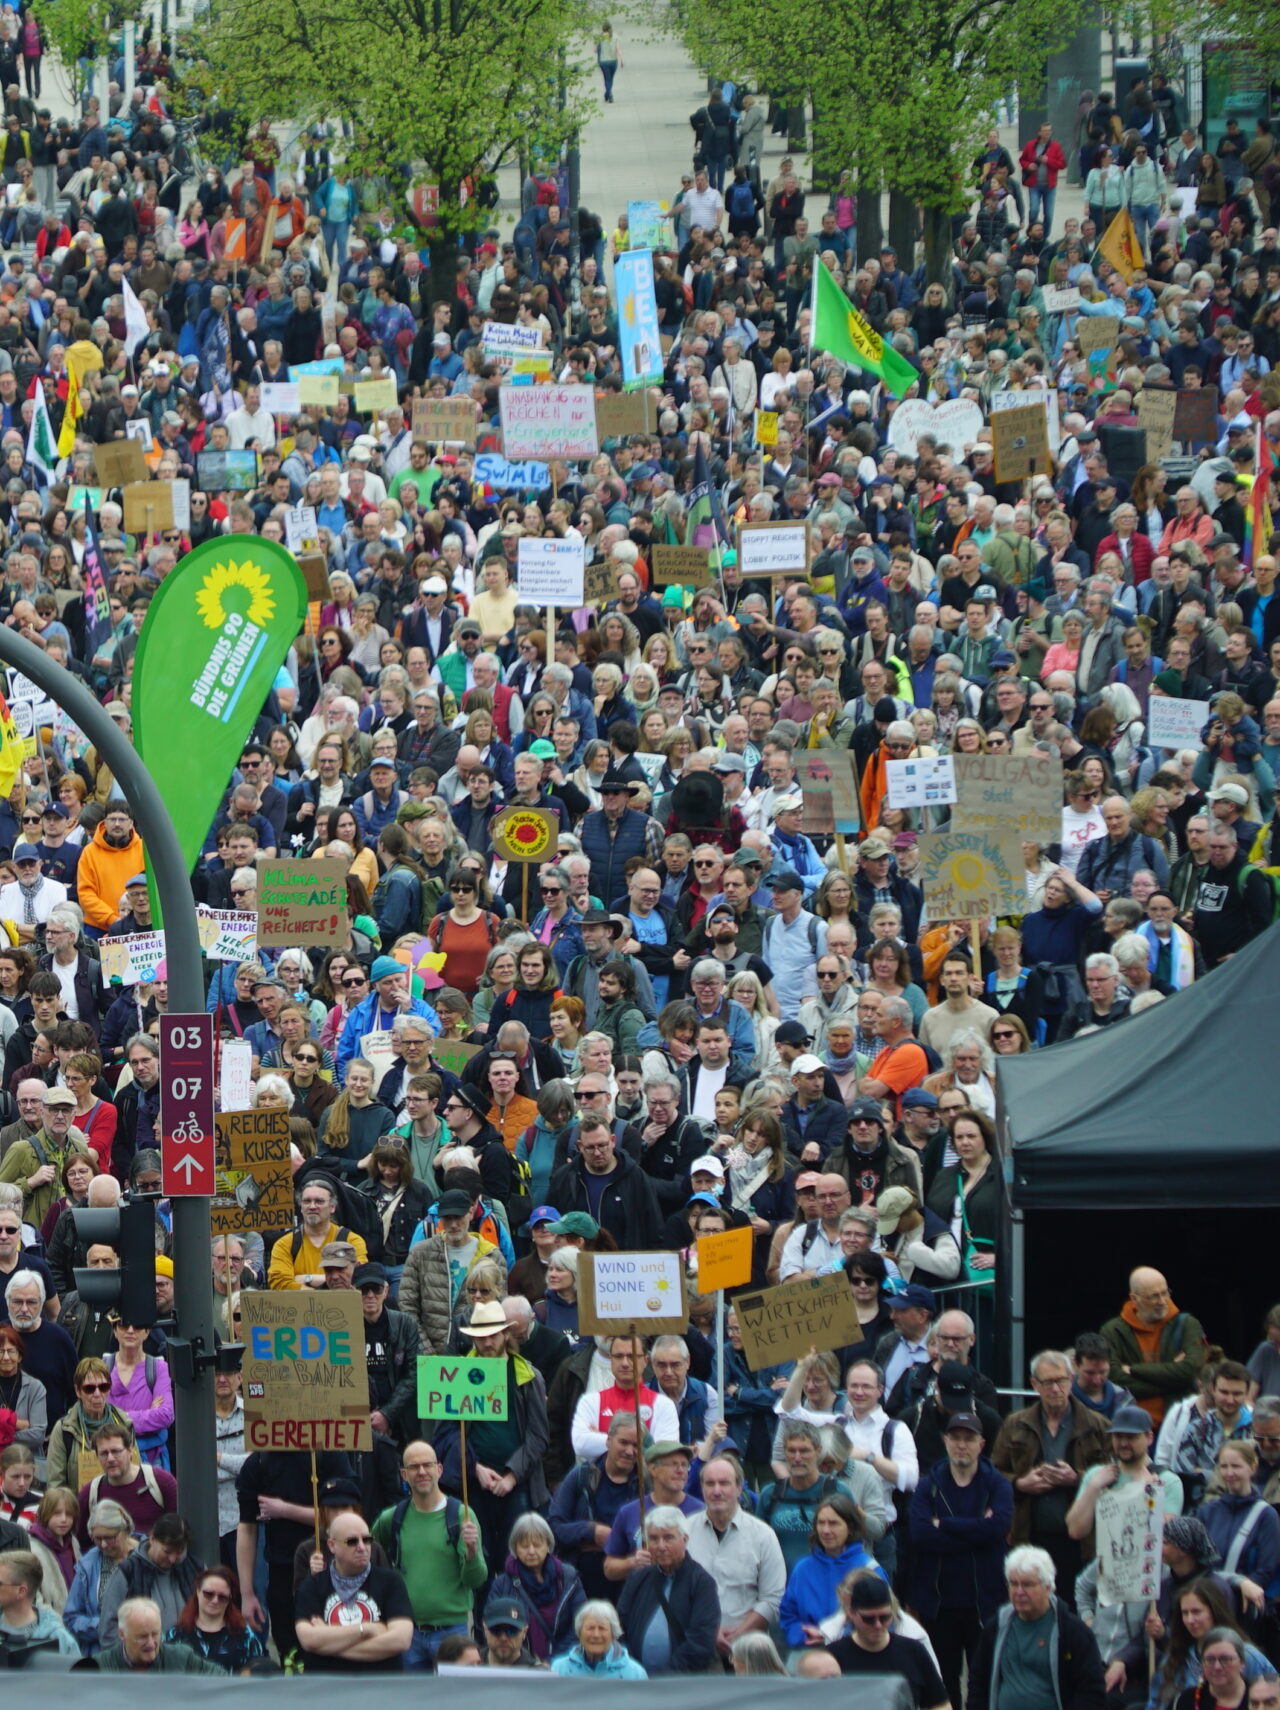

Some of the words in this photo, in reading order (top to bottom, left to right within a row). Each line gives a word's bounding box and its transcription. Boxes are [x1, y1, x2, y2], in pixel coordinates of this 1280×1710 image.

[487, 325, 511, 336] Keine
[743, 535, 769, 544] STOPPT
[521, 559, 546, 568] Vorrang
[656, 551, 671, 559] DIE
[744, 555, 769, 564] LOBBY
[771, 554, 800, 563] POLITIK
[520, 577, 549, 586] Energien
[550, 577, 573, 585] sichert
[190, 635, 233, 708] BÜNDNIS
[223, 611, 244, 637] 90
[205, 687, 229, 719] DIE
[220, 621, 261, 688] GRÜNEN
[956, 758, 1051, 788] VOLLGAS
[199, 908, 258, 923] RNEUERBARE
[265, 906, 290, 917] UNS
[221, 922, 257, 933] ENERGIE
[98, 932, 157, 947] ERNEUERBARE
[129, 939, 164, 952] ENERGIE
[170, 1026, 203, 1050] 03
[171, 1078, 203, 1101] 07
[230, 1111, 290, 1136] REICHES
[242, 1138, 291, 1163] KURS?
[210, 1208, 294, 1233] MA-SCHADEN
[597, 1260, 636, 1274] WIND
[640, 1261, 666, 1273] und
[598, 1280, 646, 1293] SONNE
[243, 1296, 298, 1325] Wäre
[303, 1296, 349, 1331] die
[743, 1288, 850, 1329] WIRTSCHAFT
[752, 1313, 834, 1348] RETTEN
[250, 1325, 353, 1366] ERDE
[250, 1361, 291, 1382] eine
[292, 1359, 356, 1389] BANK
[428, 1390, 486, 1416] PLAN
[491, 1398, 503, 1415] B
[250, 1419, 366, 1450] GERETTET
